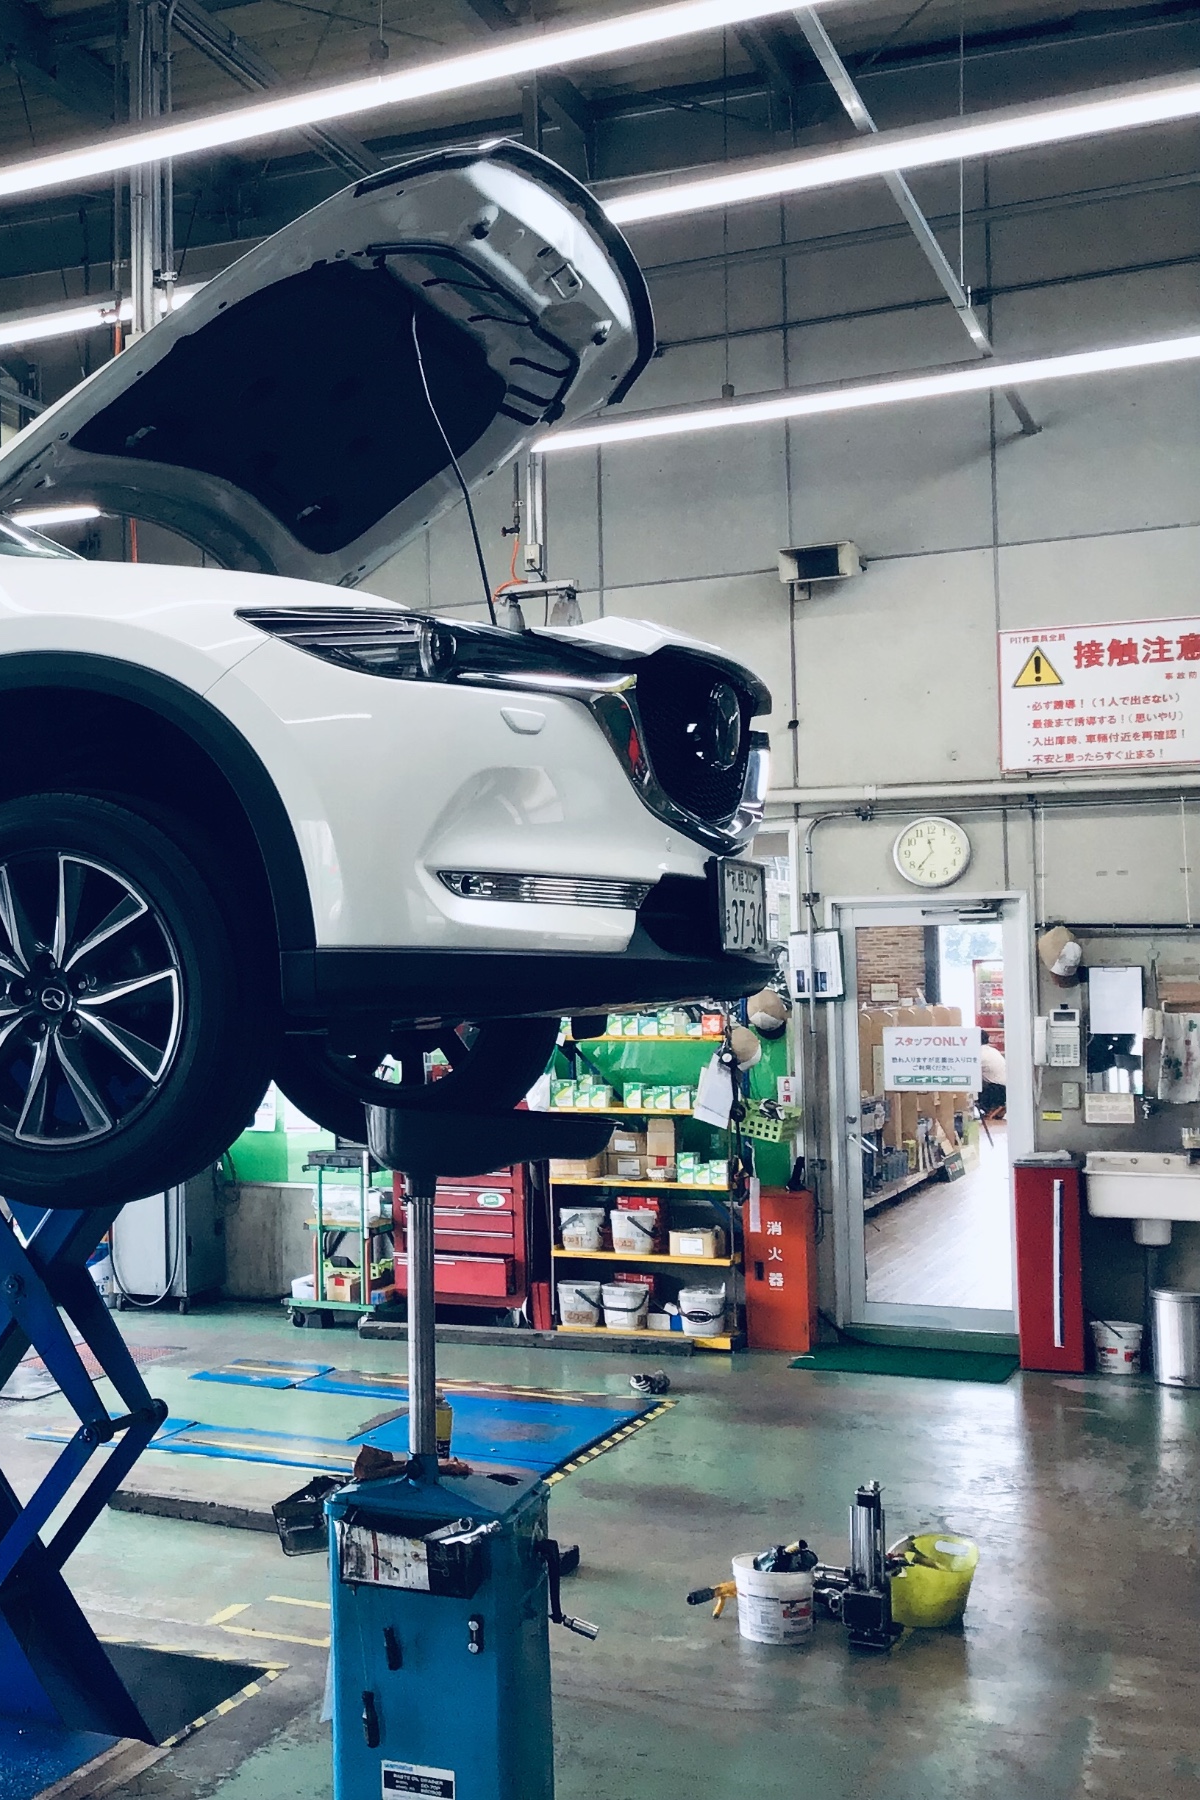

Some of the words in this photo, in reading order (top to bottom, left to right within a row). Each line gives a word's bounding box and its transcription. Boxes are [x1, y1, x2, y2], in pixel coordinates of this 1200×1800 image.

[1073, 633, 1200, 669] 接触注意
[927, 826, 935, 834] 12
[908, 838, 916, 846] 10
[904, 850, 911, 858] 9
[943, 868, 948, 876] 5
[894, 1036, 968, 1047] スタッフONLY
[766, 1221, 784, 1287] 消火器
